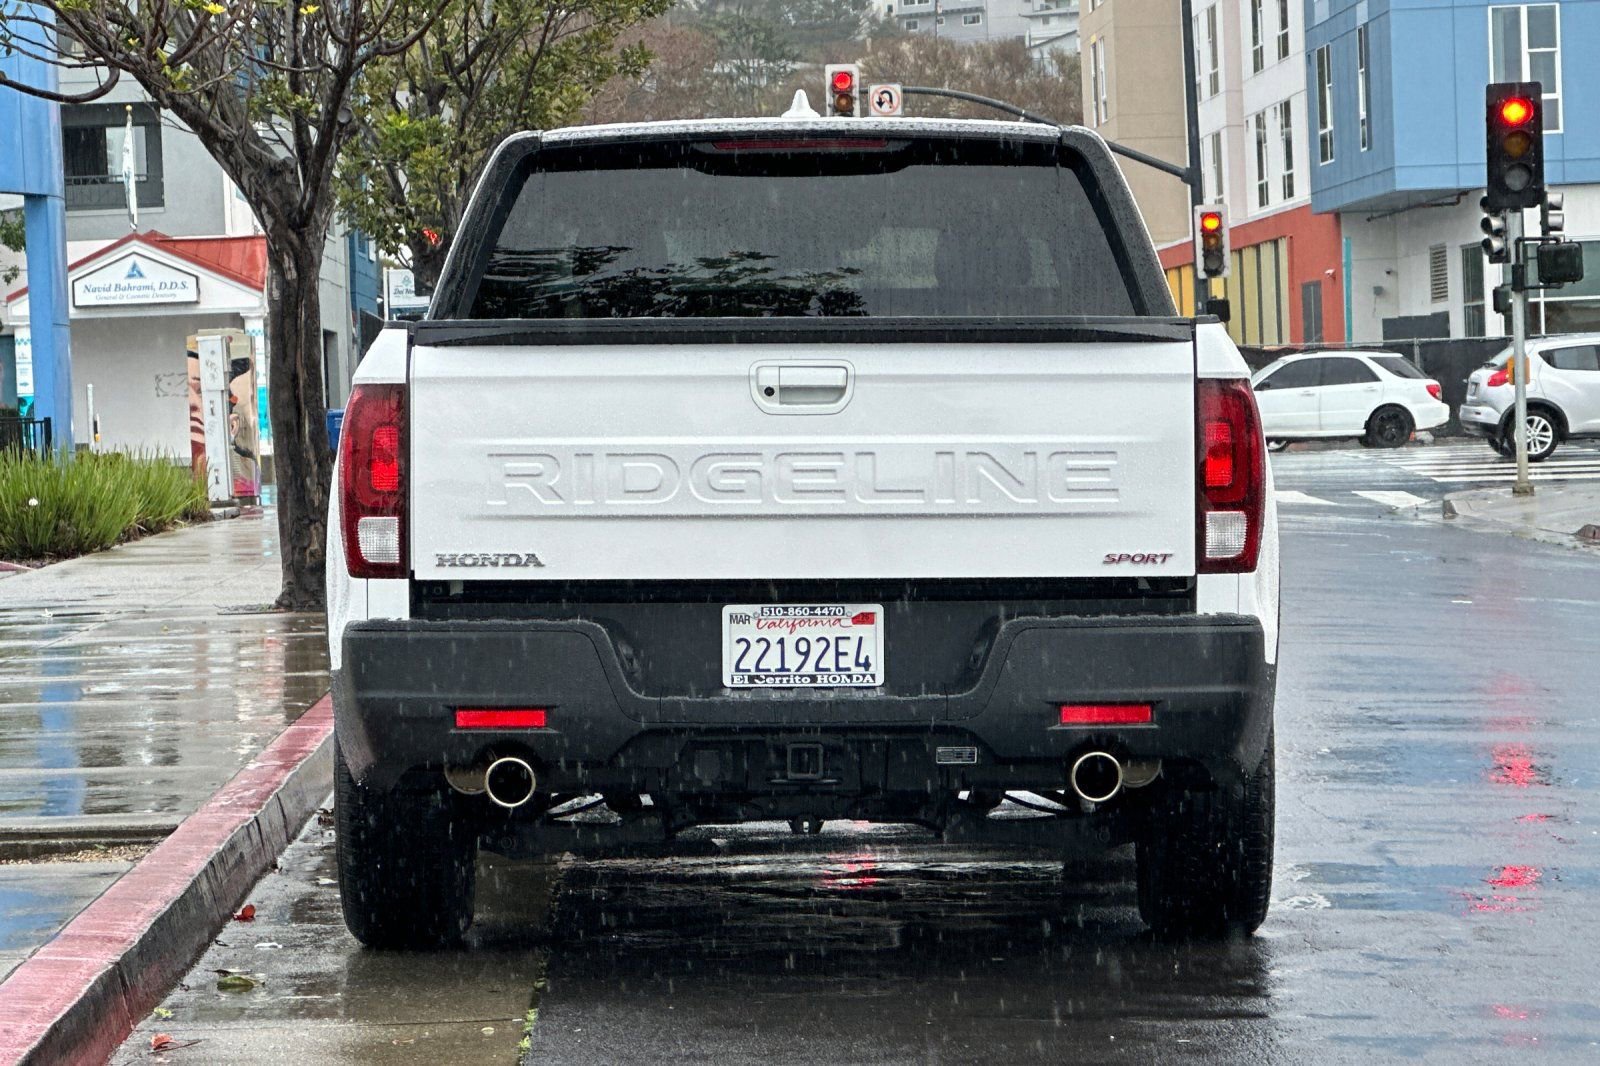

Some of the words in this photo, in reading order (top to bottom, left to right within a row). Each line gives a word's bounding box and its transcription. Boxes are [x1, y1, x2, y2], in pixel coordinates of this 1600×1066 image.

[83, 284, 112, 294] Navid
[114, 282, 156, 293] Bahrami,
[158, 281, 189, 291] D.D.S.
[486, 451, 1121, 505] RIDGELINE
[435, 553, 546, 568] HONDA
[1102, 553, 1174, 565] SPORT
[762, 607, 844, 616] 510-860-4470
[729, 614, 750, 624] MAR
[756, 617, 852, 634] California
[734, 636, 872, 673] 22192E4
[733, 675, 750, 685] El
[754, 674, 811, 685] Cerrito
[816, 675, 875, 685] HONDA
